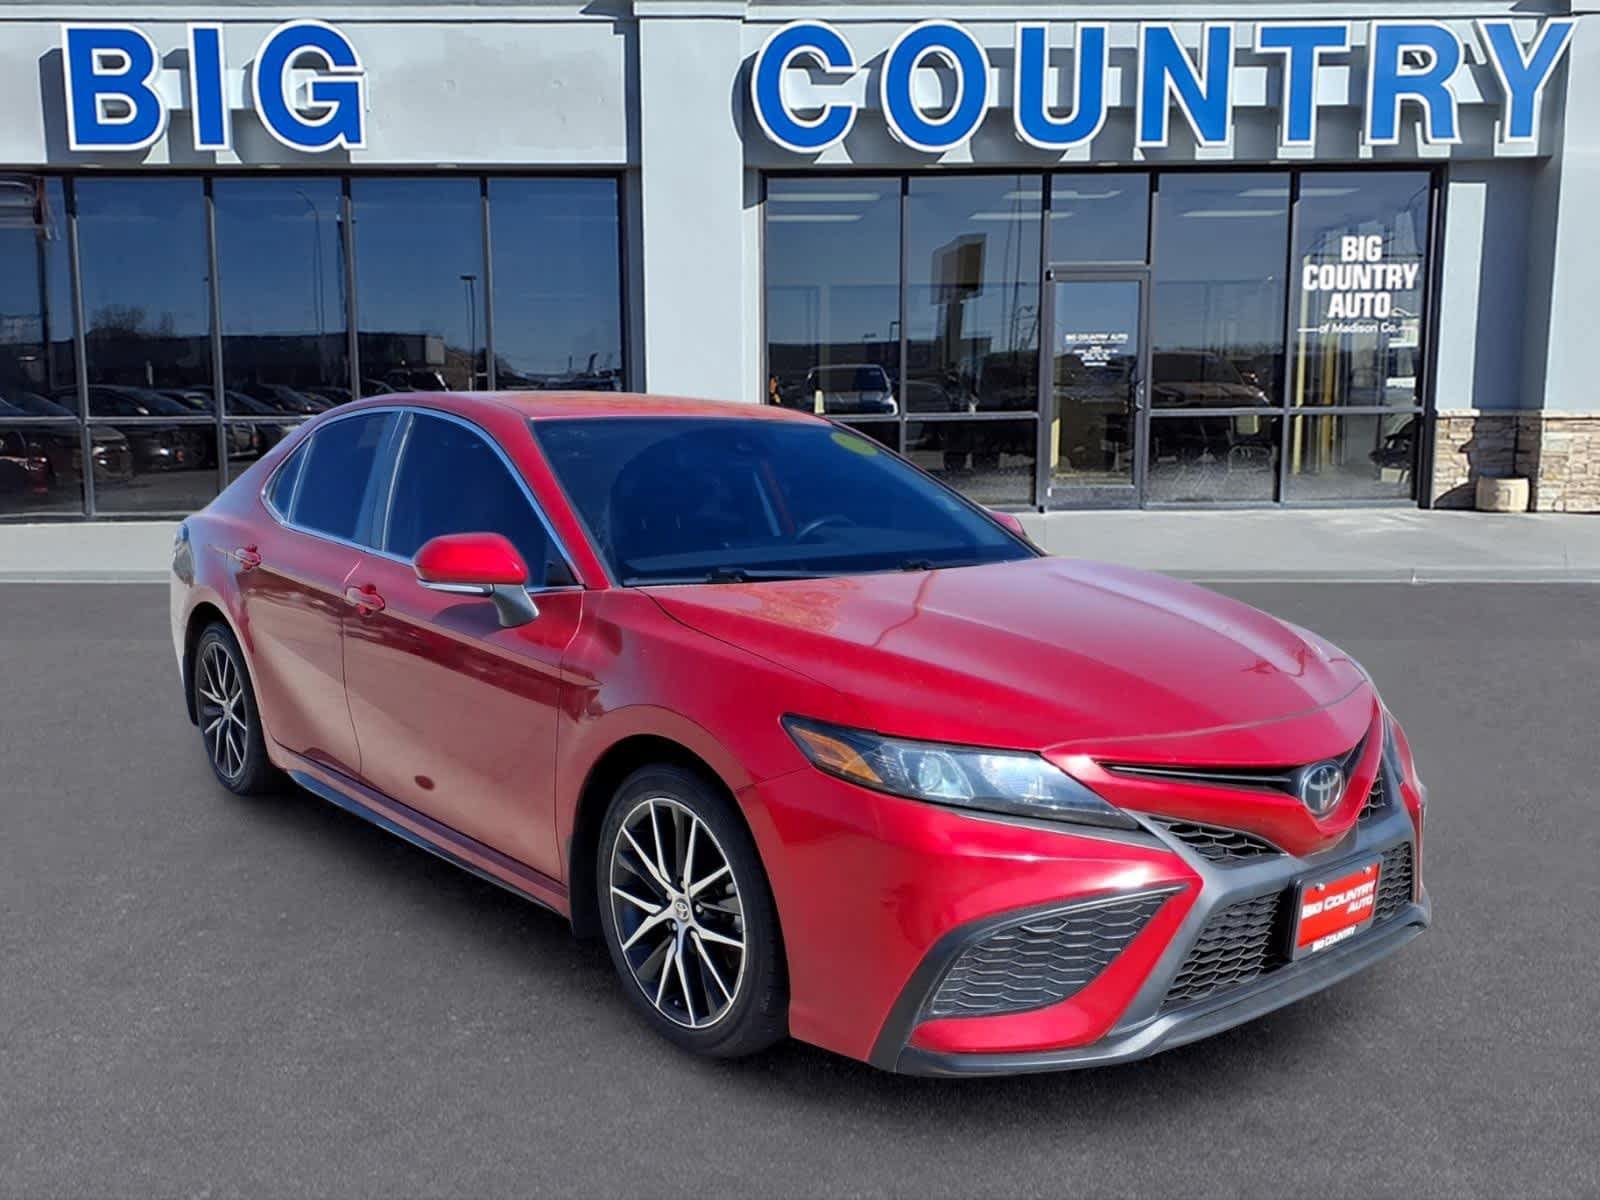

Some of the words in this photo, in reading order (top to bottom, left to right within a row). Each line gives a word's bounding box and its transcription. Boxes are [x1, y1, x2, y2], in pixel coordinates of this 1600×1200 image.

[61, 19, 368, 153] BIG
[750, 19, 1576, 154] COUNTRY
[1341, 235, 1382, 262] BIG
[1303, 263, 1420, 290] COUNTRY
[1327, 292, 1391, 318] AUTO
[1319, 323, 1328, 334] of
[1331, 323, 1378, 334] Madison
[1380, 323, 1398, 333] Co.
[1301, 902, 1323, 919] BIG
[1324, 880, 1376, 911] COUNTRY
[1346, 894, 1374, 914] AUTO
